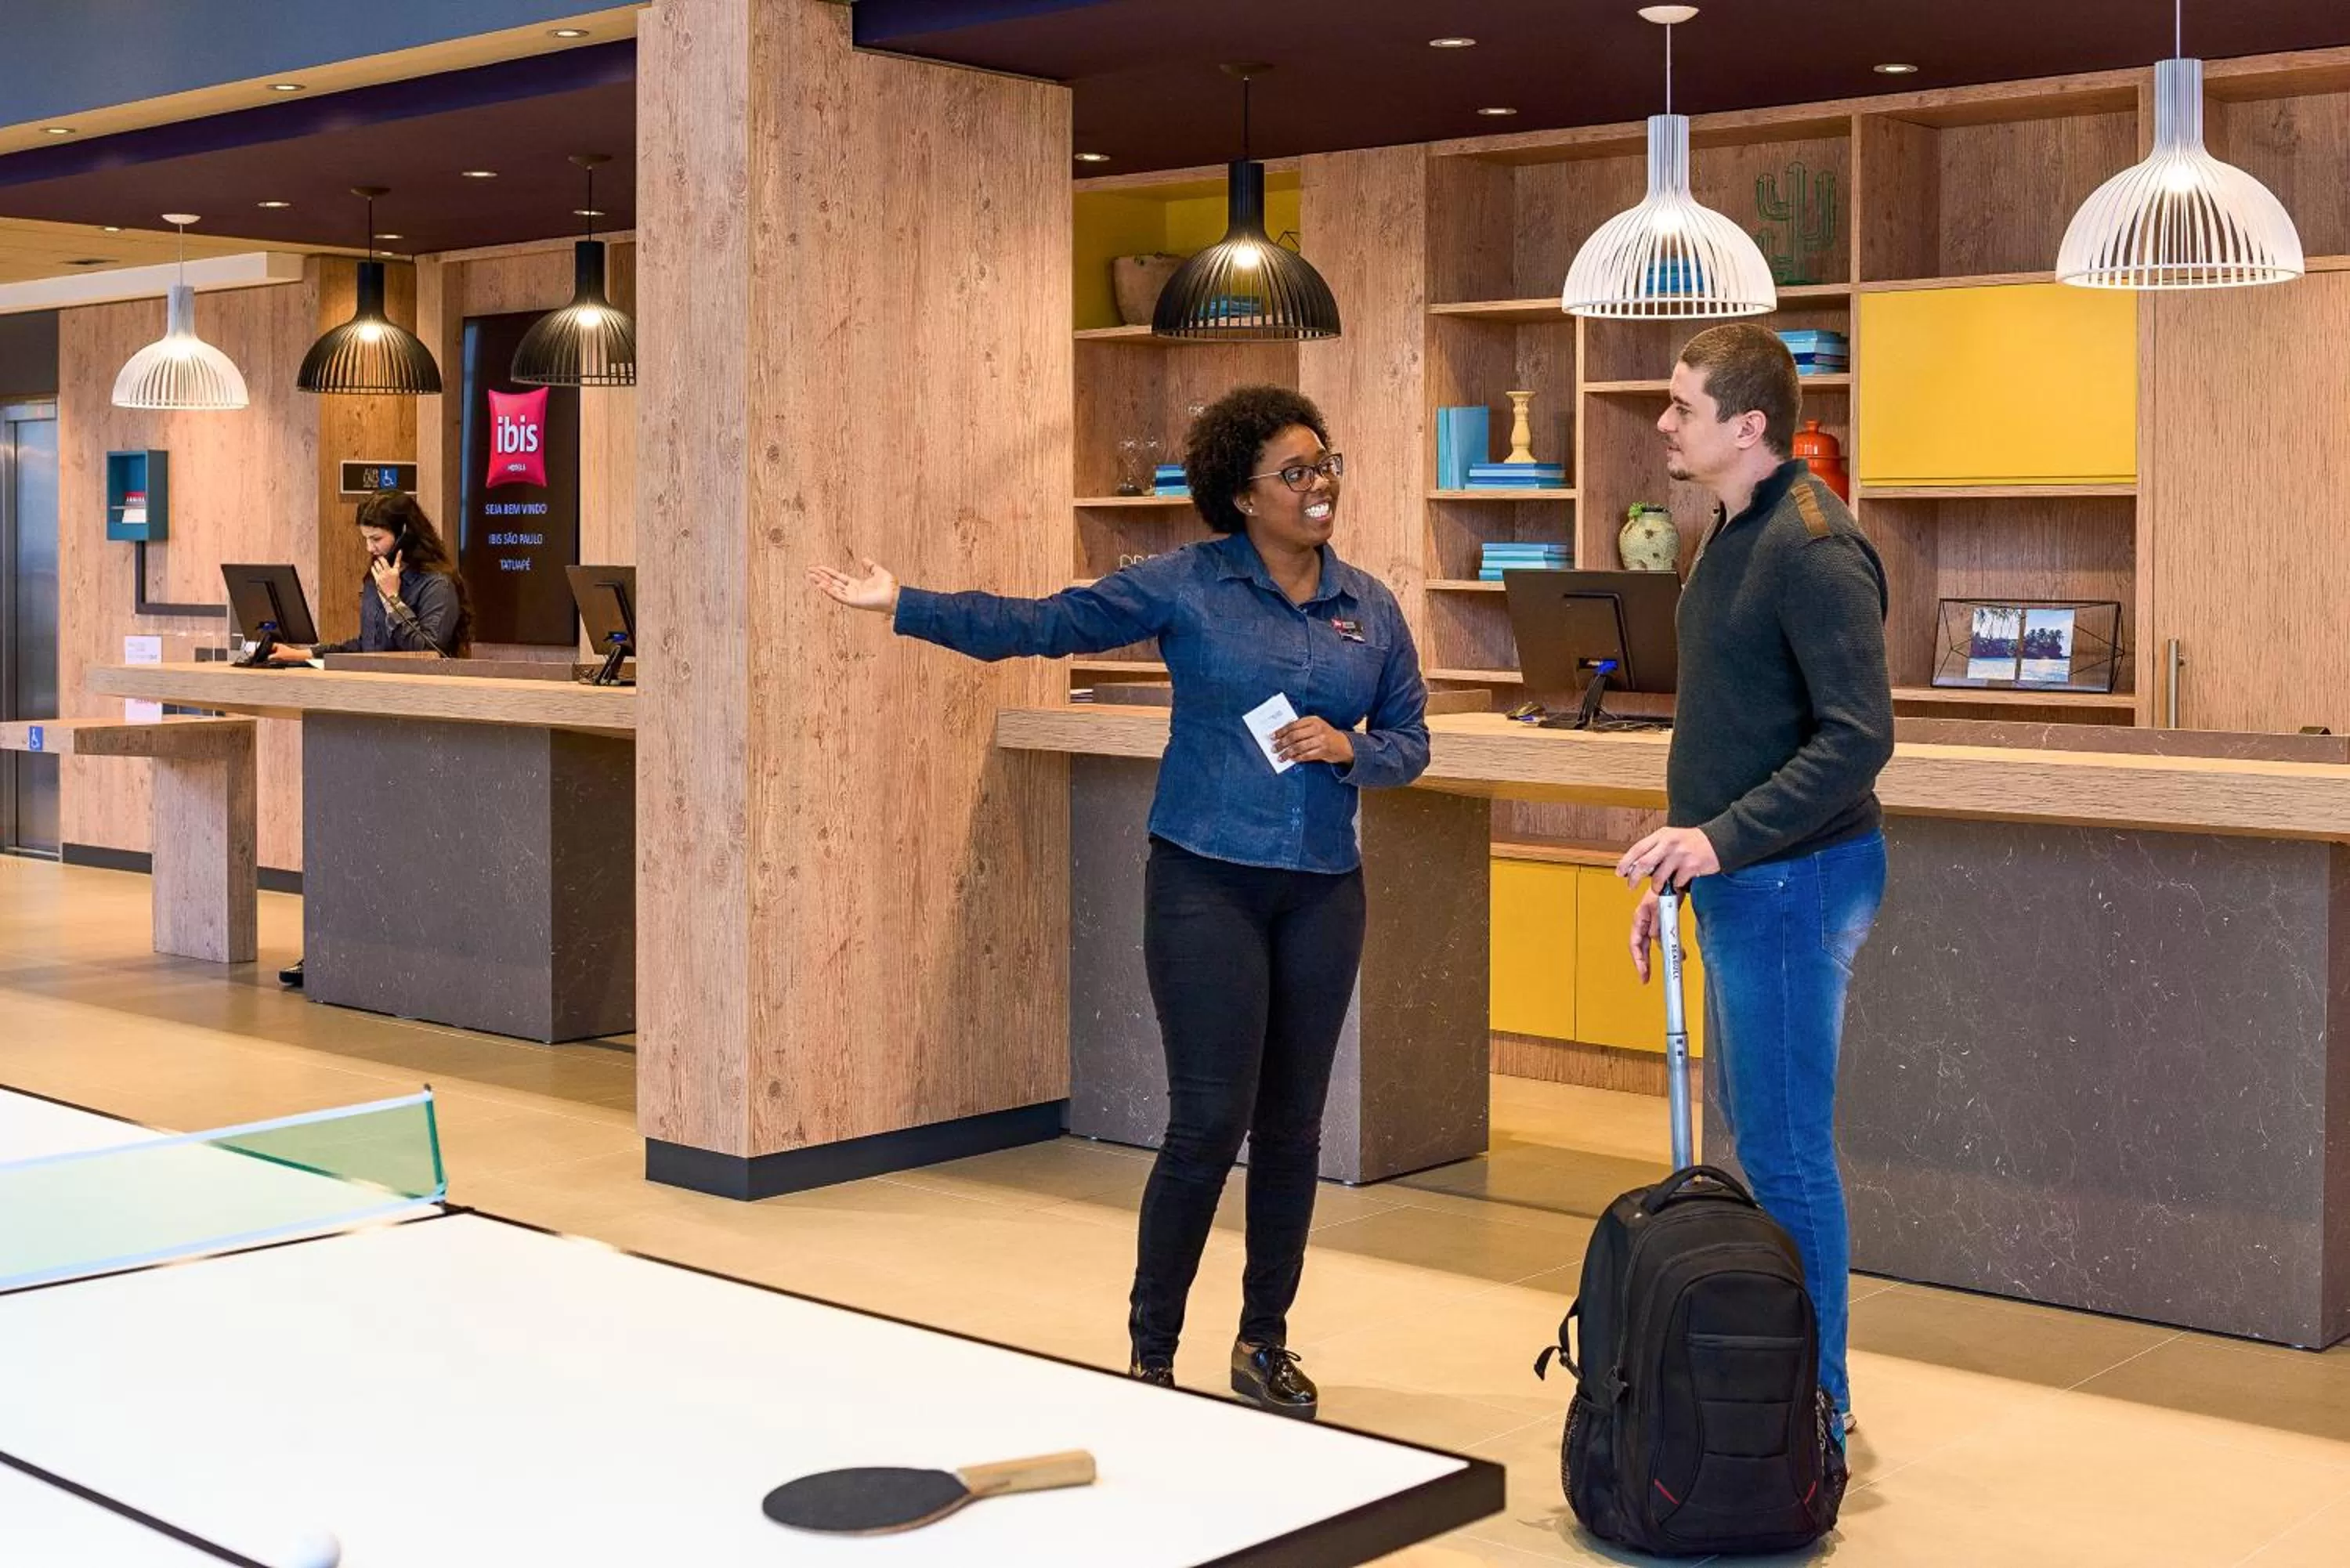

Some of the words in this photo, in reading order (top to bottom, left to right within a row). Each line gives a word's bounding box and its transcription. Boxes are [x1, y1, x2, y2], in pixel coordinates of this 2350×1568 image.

[497, 414, 538, 453] ibis
[485, 504, 502, 515] SEJA
[504, 504, 520, 515] BEM
[521, 504, 547, 515] VINDO
[488, 533, 502, 544] IBIS
[504, 531, 518, 544] SÃO
[519, 533, 543, 544] PAULO
[499, 557, 531, 571] TATUAPÉ
